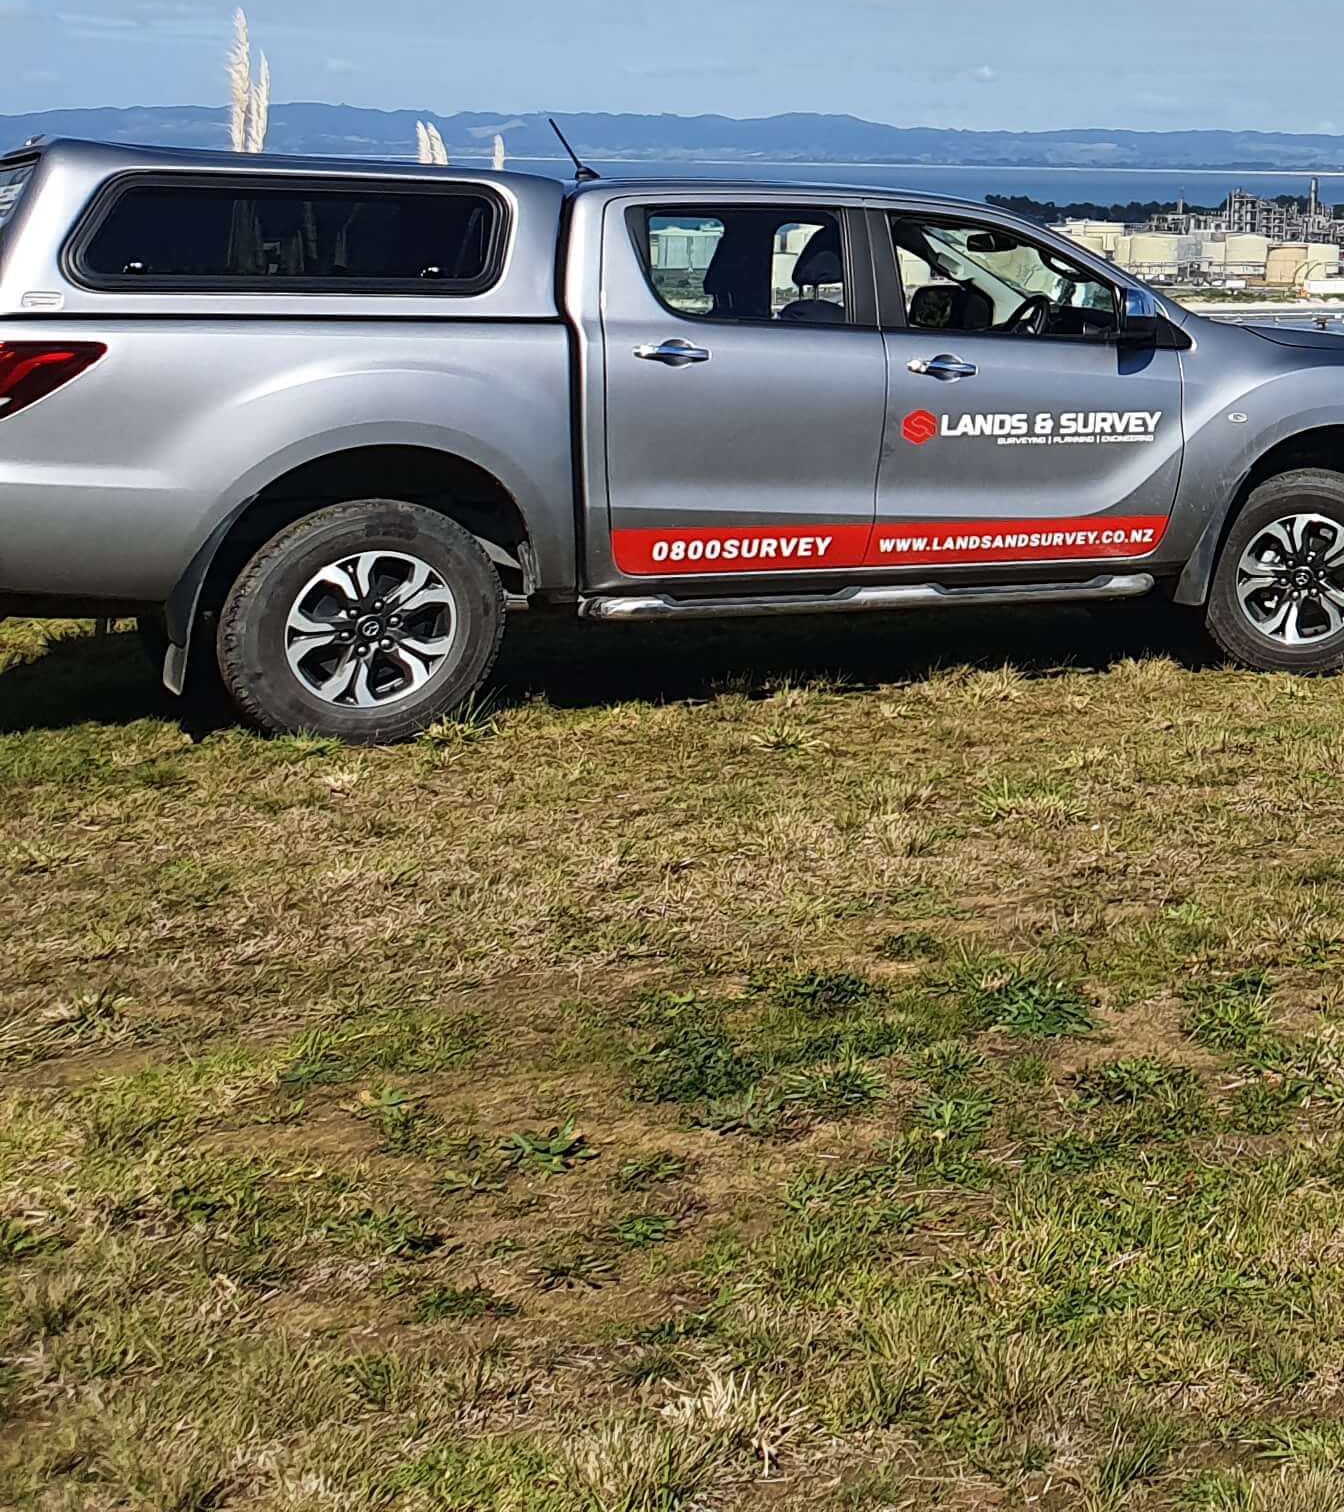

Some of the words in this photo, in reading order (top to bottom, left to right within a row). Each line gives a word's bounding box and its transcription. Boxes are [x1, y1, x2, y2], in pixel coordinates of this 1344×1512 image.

[940, 413, 1028, 436] LANDS
[1034, 413, 1054, 435] &
[1059, 411, 1162, 434] SURVEY
[651, 536, 832, 562] 0800SURVEY
[879, 528, 1155, 553] WWW.LANDSANDSURVEY.CO.NZ
